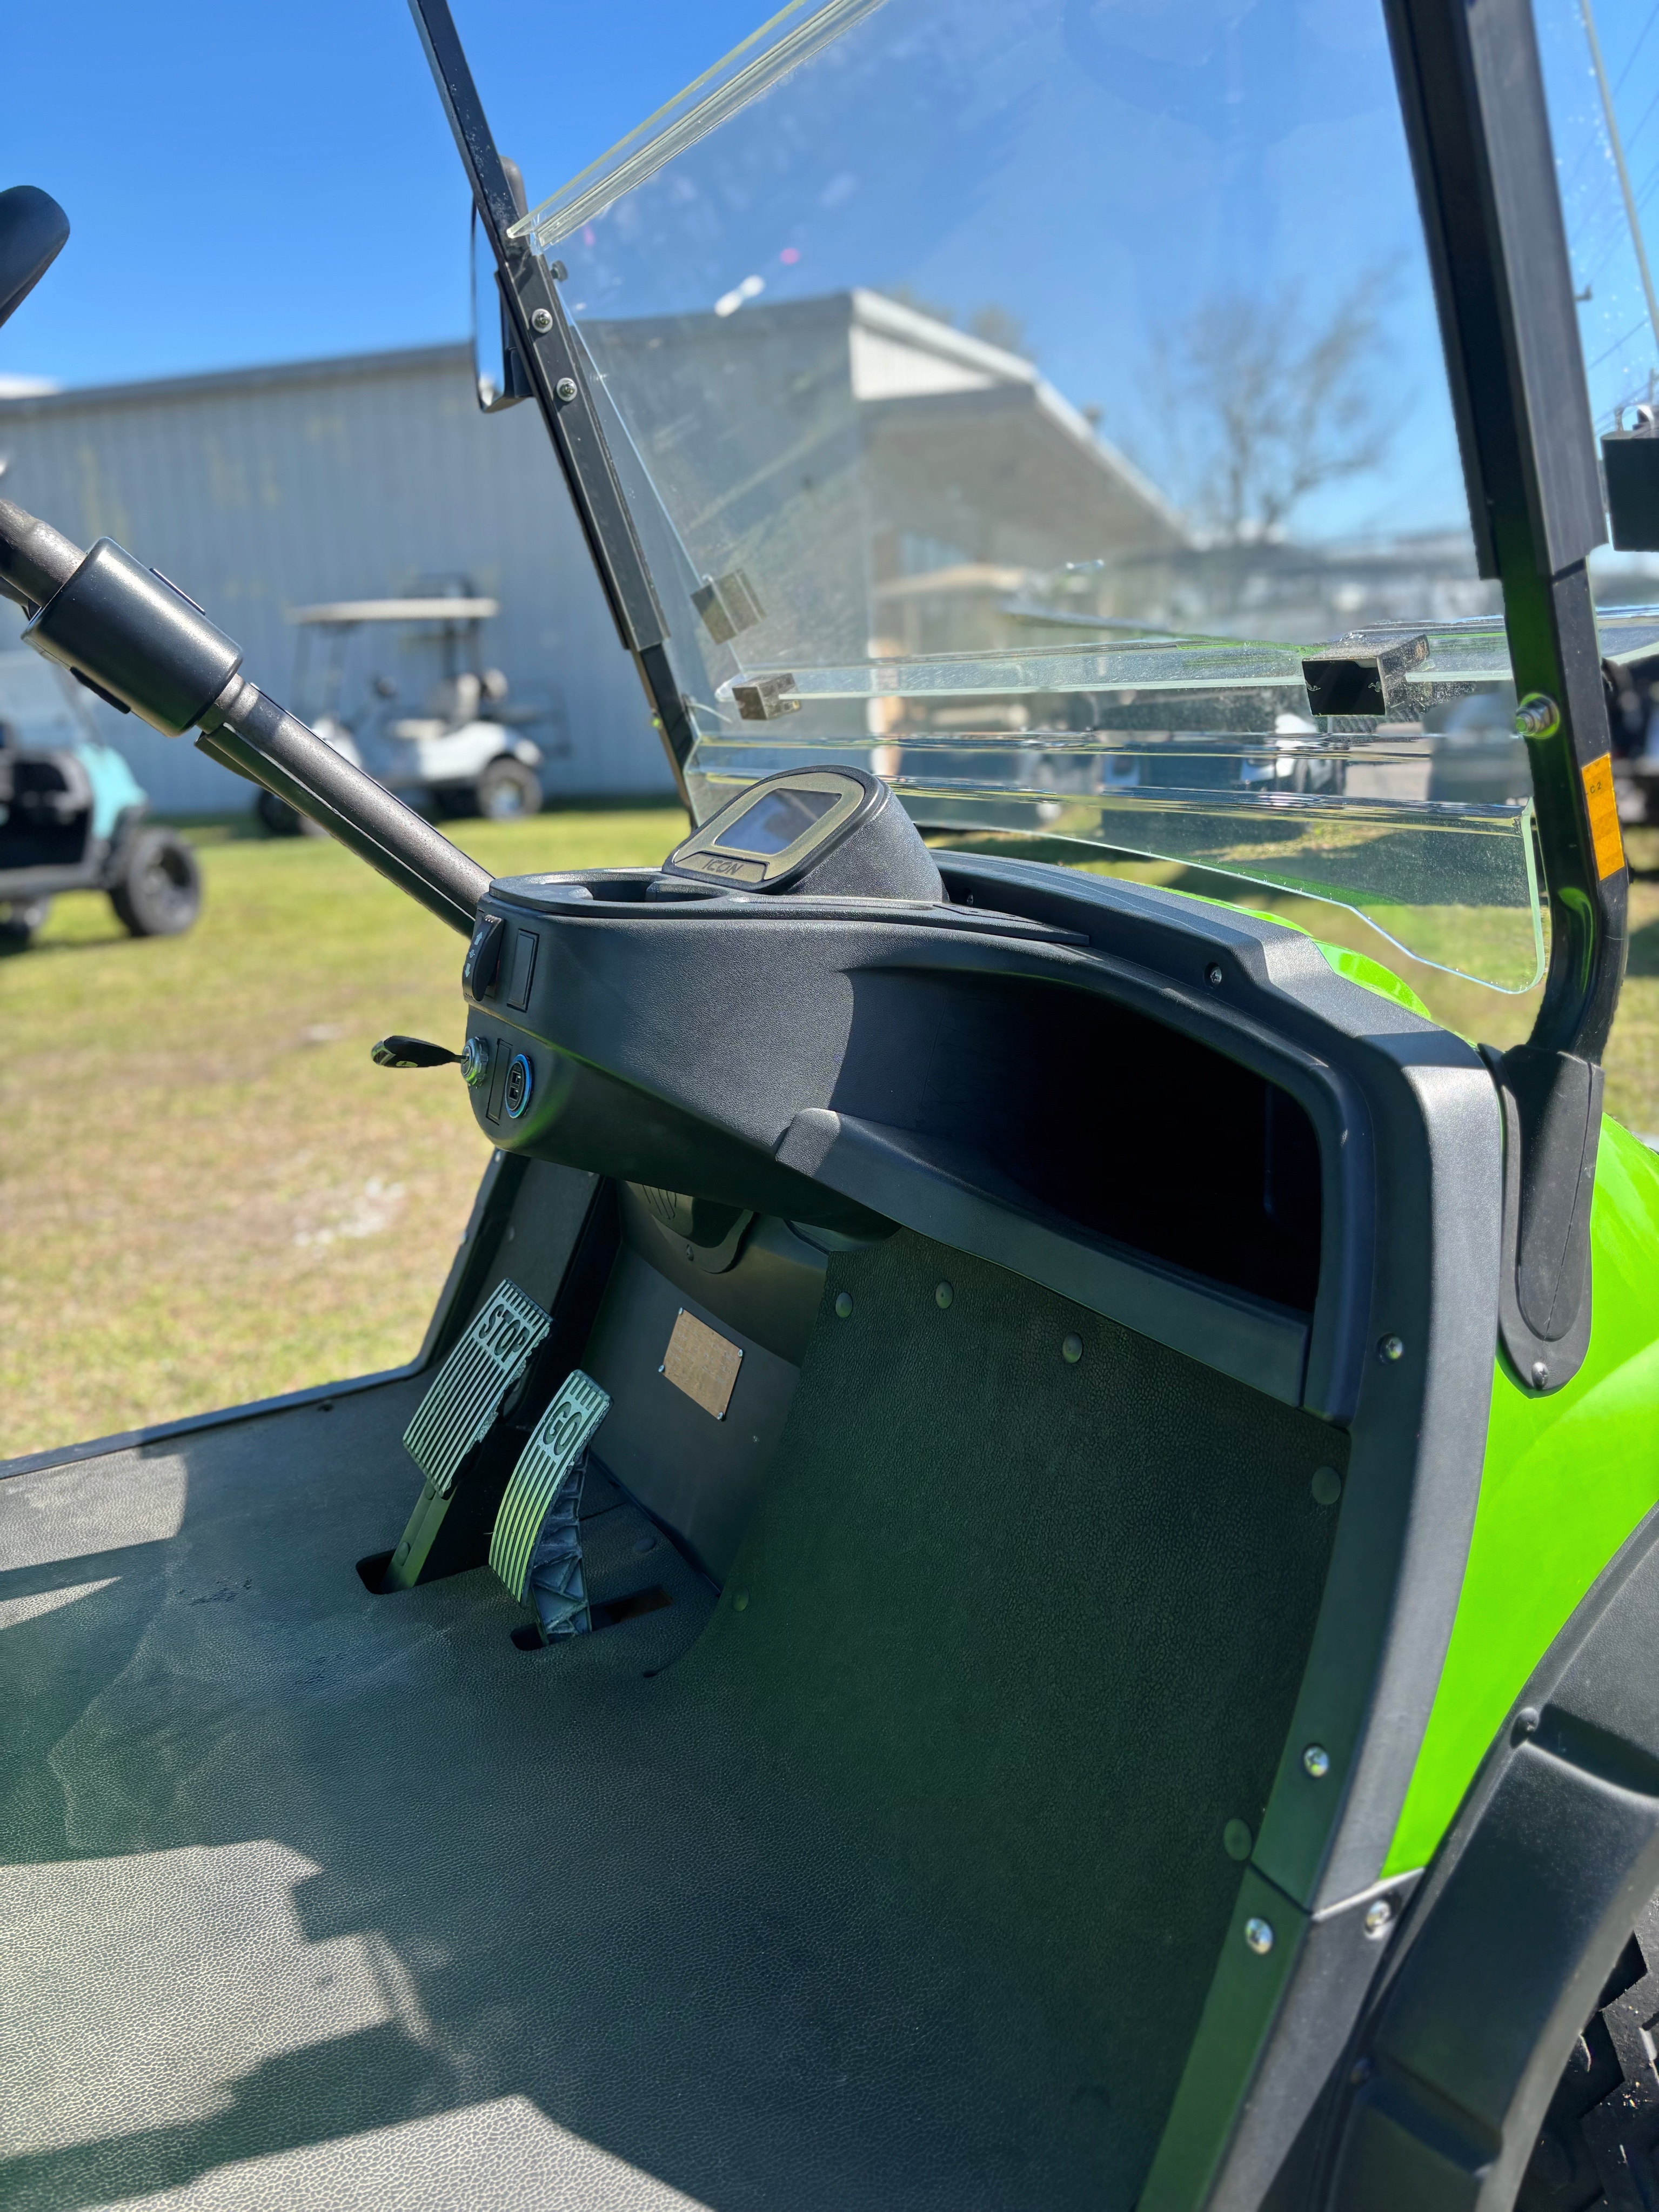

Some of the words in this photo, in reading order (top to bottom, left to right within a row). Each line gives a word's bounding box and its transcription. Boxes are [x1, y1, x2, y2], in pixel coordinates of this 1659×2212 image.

[702, 859, 744, 875] ICON
[479, 1304, 530, 1363] STOP
[543, 1401, 583, 1456] GO
